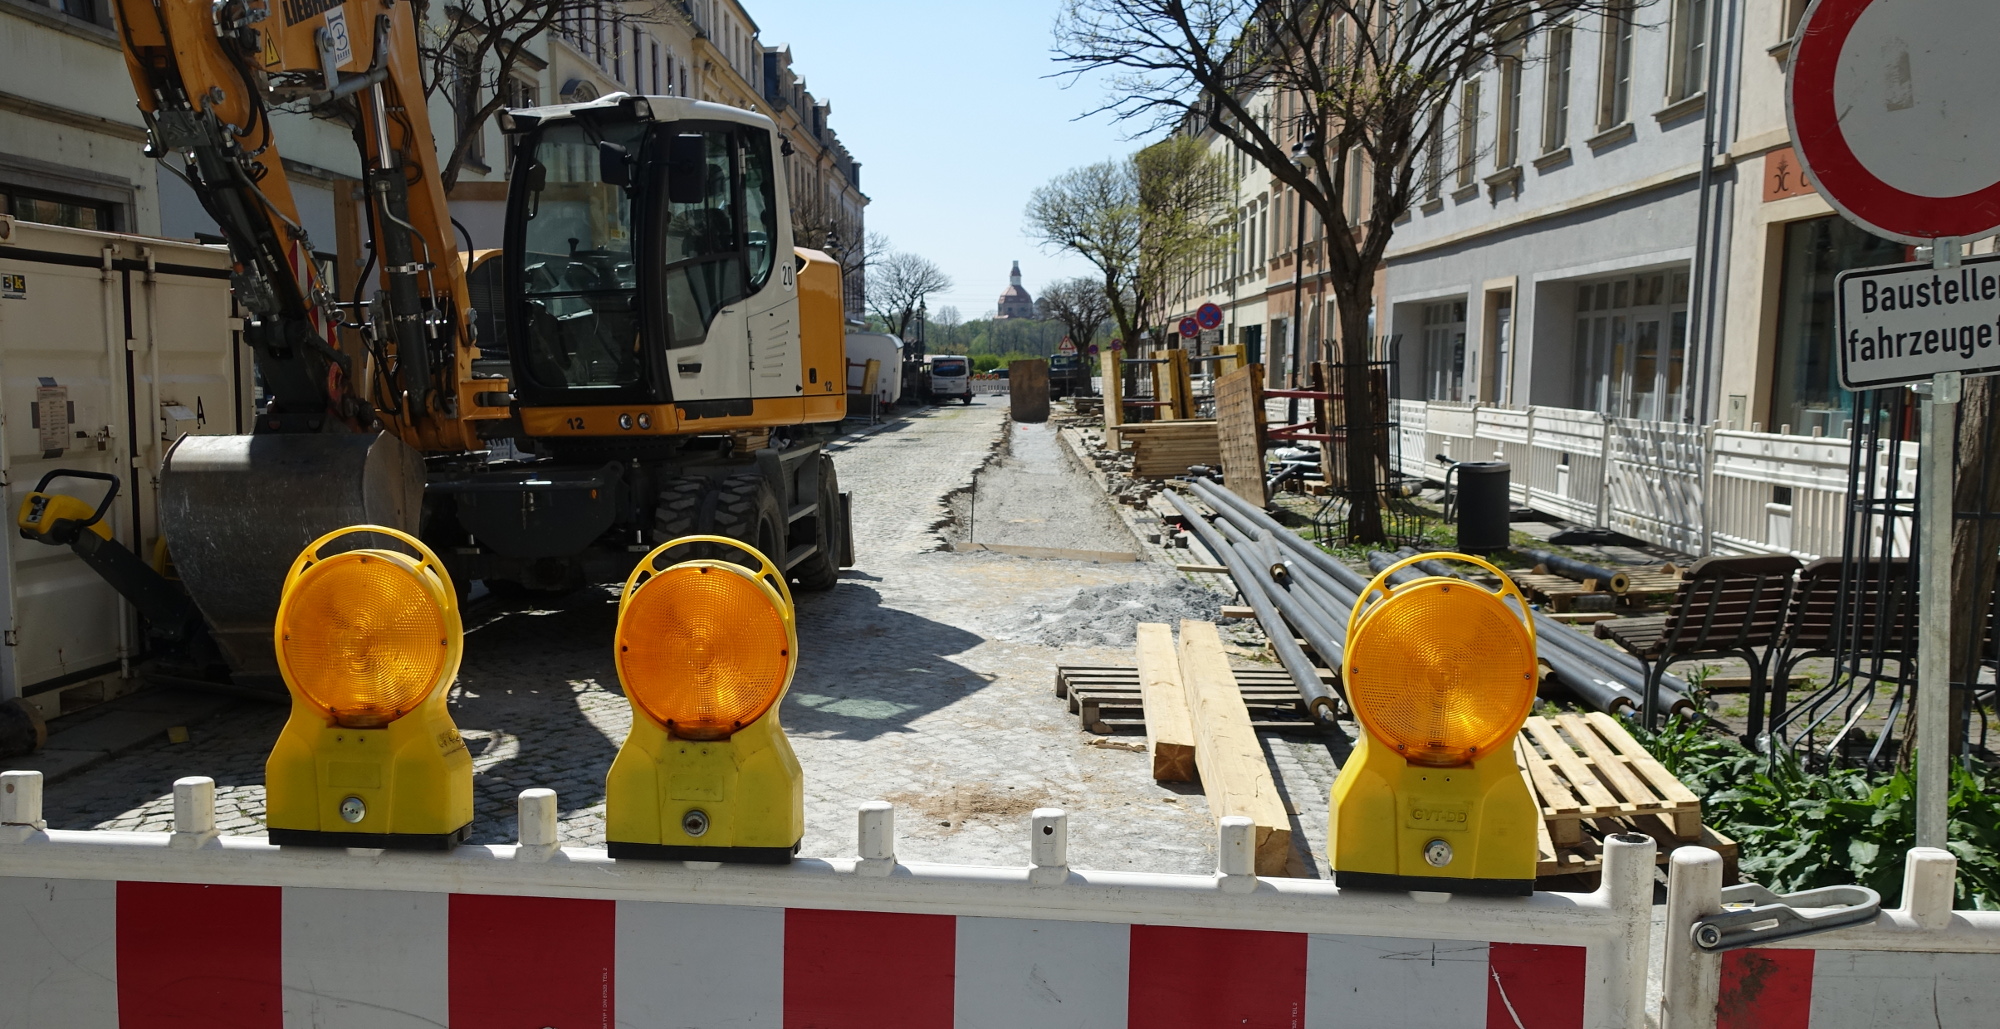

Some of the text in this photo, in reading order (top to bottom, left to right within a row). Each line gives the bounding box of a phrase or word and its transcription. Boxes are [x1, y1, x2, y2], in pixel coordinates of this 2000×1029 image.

[782, 265, 793, 286] 20
[1862, 268, 2000, 313] Baustelle
[1848, 324, 1992, 362] fahrzeuge
[824, 381, 833, 392] 12
[567, 417, 585, 430] 12
